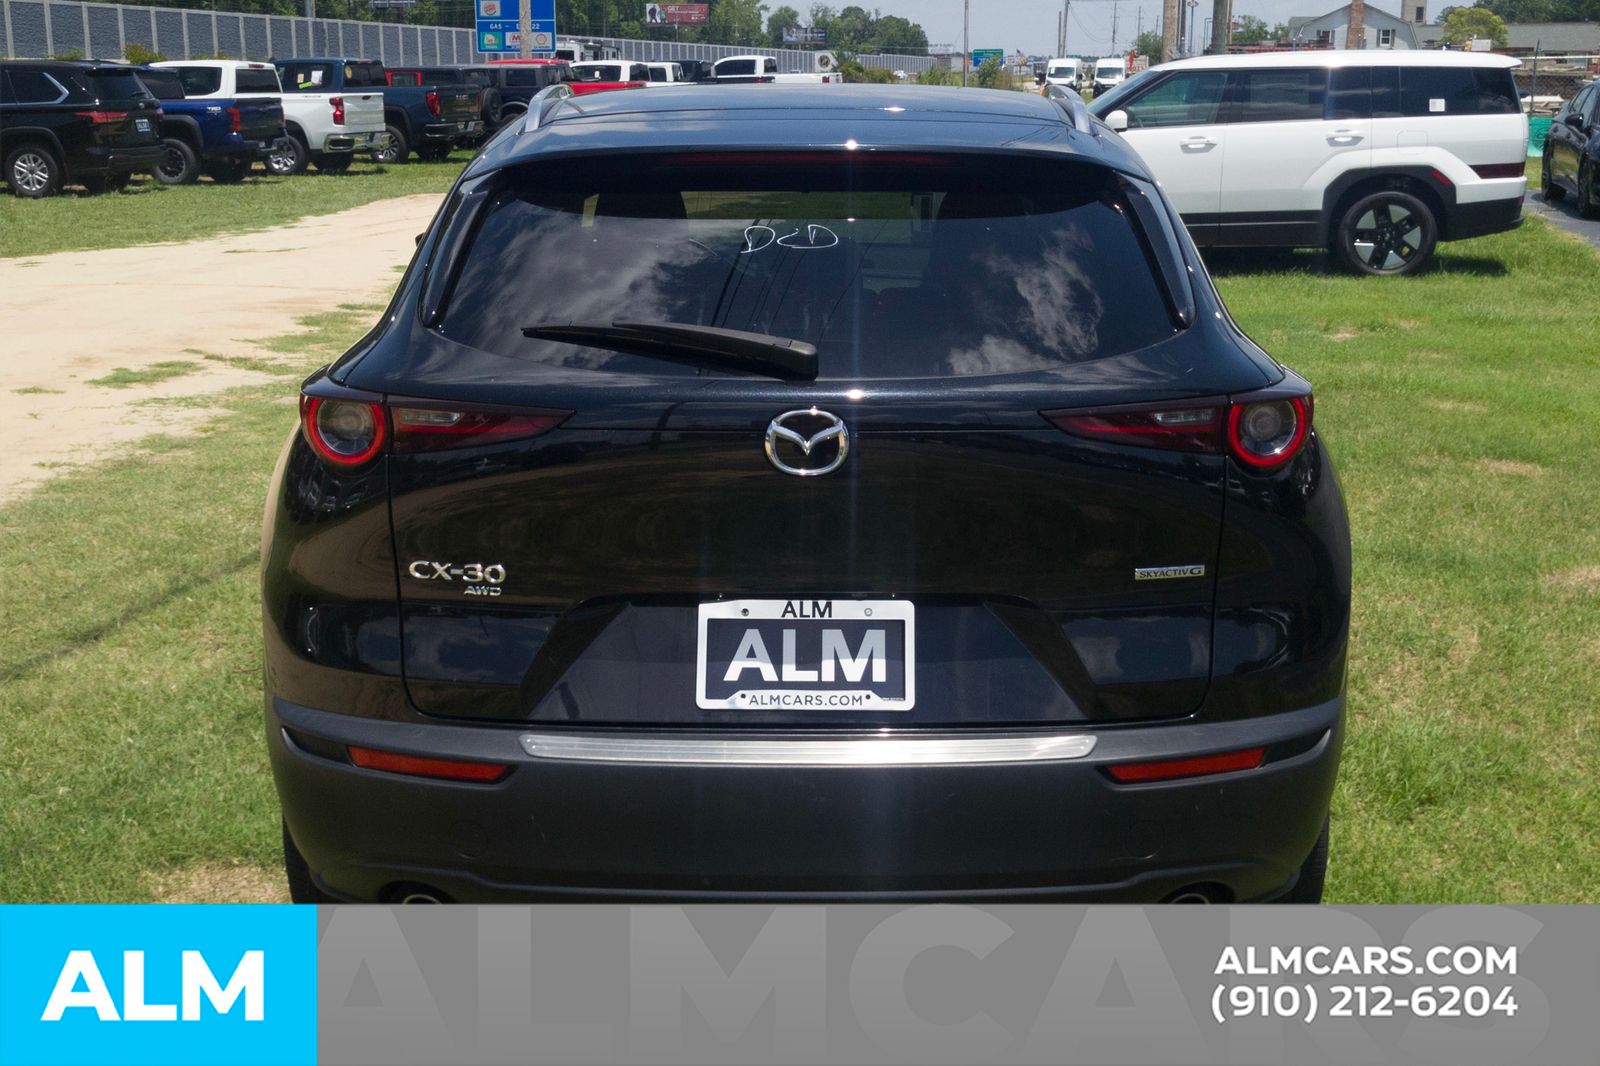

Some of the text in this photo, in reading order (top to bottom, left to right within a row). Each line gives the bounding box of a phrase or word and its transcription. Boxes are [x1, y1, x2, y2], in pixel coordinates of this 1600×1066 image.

[408, 560, 507, 584] CX-30
[463, 585, 502, 596] AWD
[781, 600, 833, 618] ALM
[723, 628, 887, 682] ALM
[749, 694, 863, 706] ALMCARS.COM
